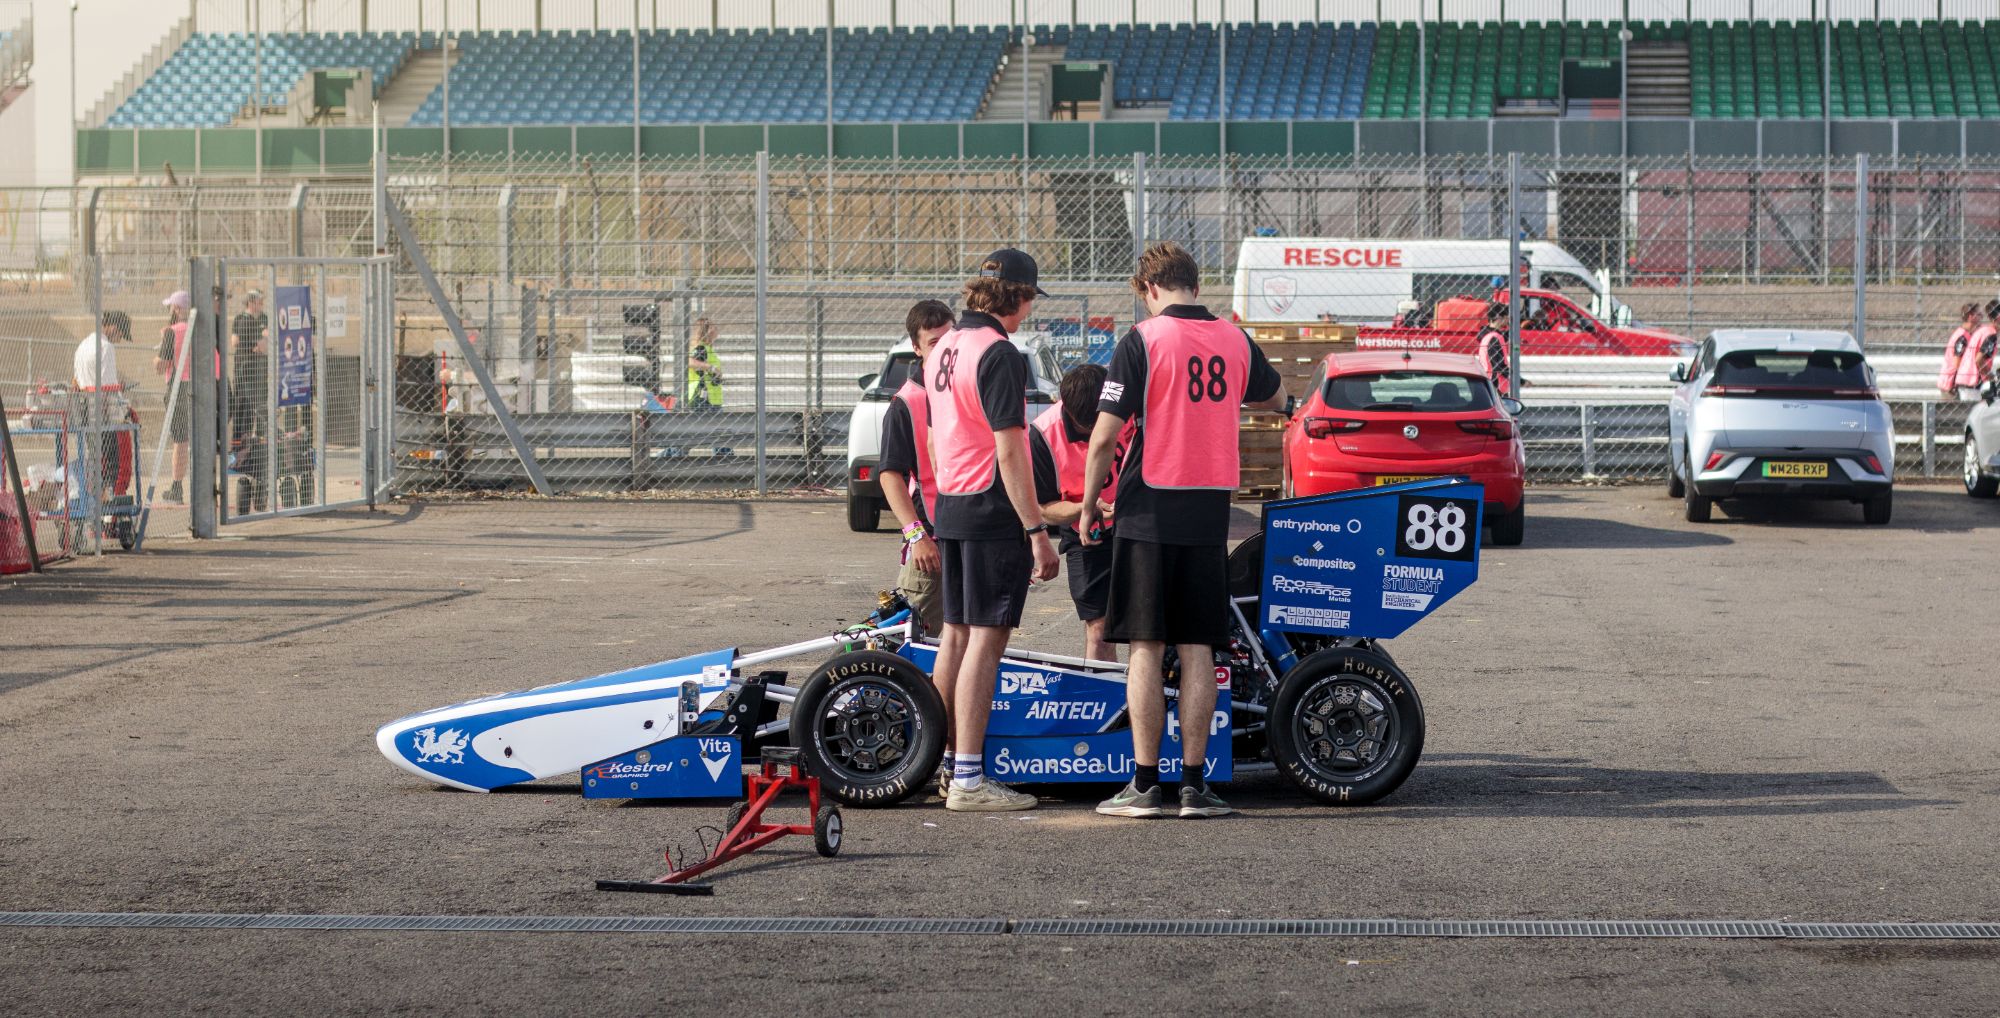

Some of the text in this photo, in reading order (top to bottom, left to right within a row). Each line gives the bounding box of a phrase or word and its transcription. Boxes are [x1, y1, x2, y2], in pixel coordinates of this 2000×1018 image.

[1284, 248, 1402, 267] RESCUE
[1051, 335, 1106, 346] ESTRITED
[1355, 336, 1441, 348] lverstone.co.uk
[1188, 355, 1227, 403] 88
[1770, 463, 1826, 475] WM26 RXP
[1273, 519, 1341, 533] entryphone
[1405, 503, 1466, 553] 88
[1297, 557, 1356, 570] composite
[1272, 575, 1306, 587] Pro
[1383, 564, 1444, 581] FORMULA
[1382, 577, 1442, 593] STUDENT
[1288, 616, 1341, 628] TUNING
[826, 662, 895, 685] Hoosier
[1343, 656, 1405, 696] Hoosier
[1001, 671, 1049, 694] DTA
[991, 701, 1010, 711] ESS
[1025, 700, 1107, 720] AIRTECH
[1167, 710, 1229, 736] HP
[698, 738, 732, 753] Vita
[609, 761, 673, 773] Kestrel
[994, 753, 1103, 775] Swansea
[839, 777, 909, 800] Hoosier
[1288, 761, 1353, 800] Hoosier
